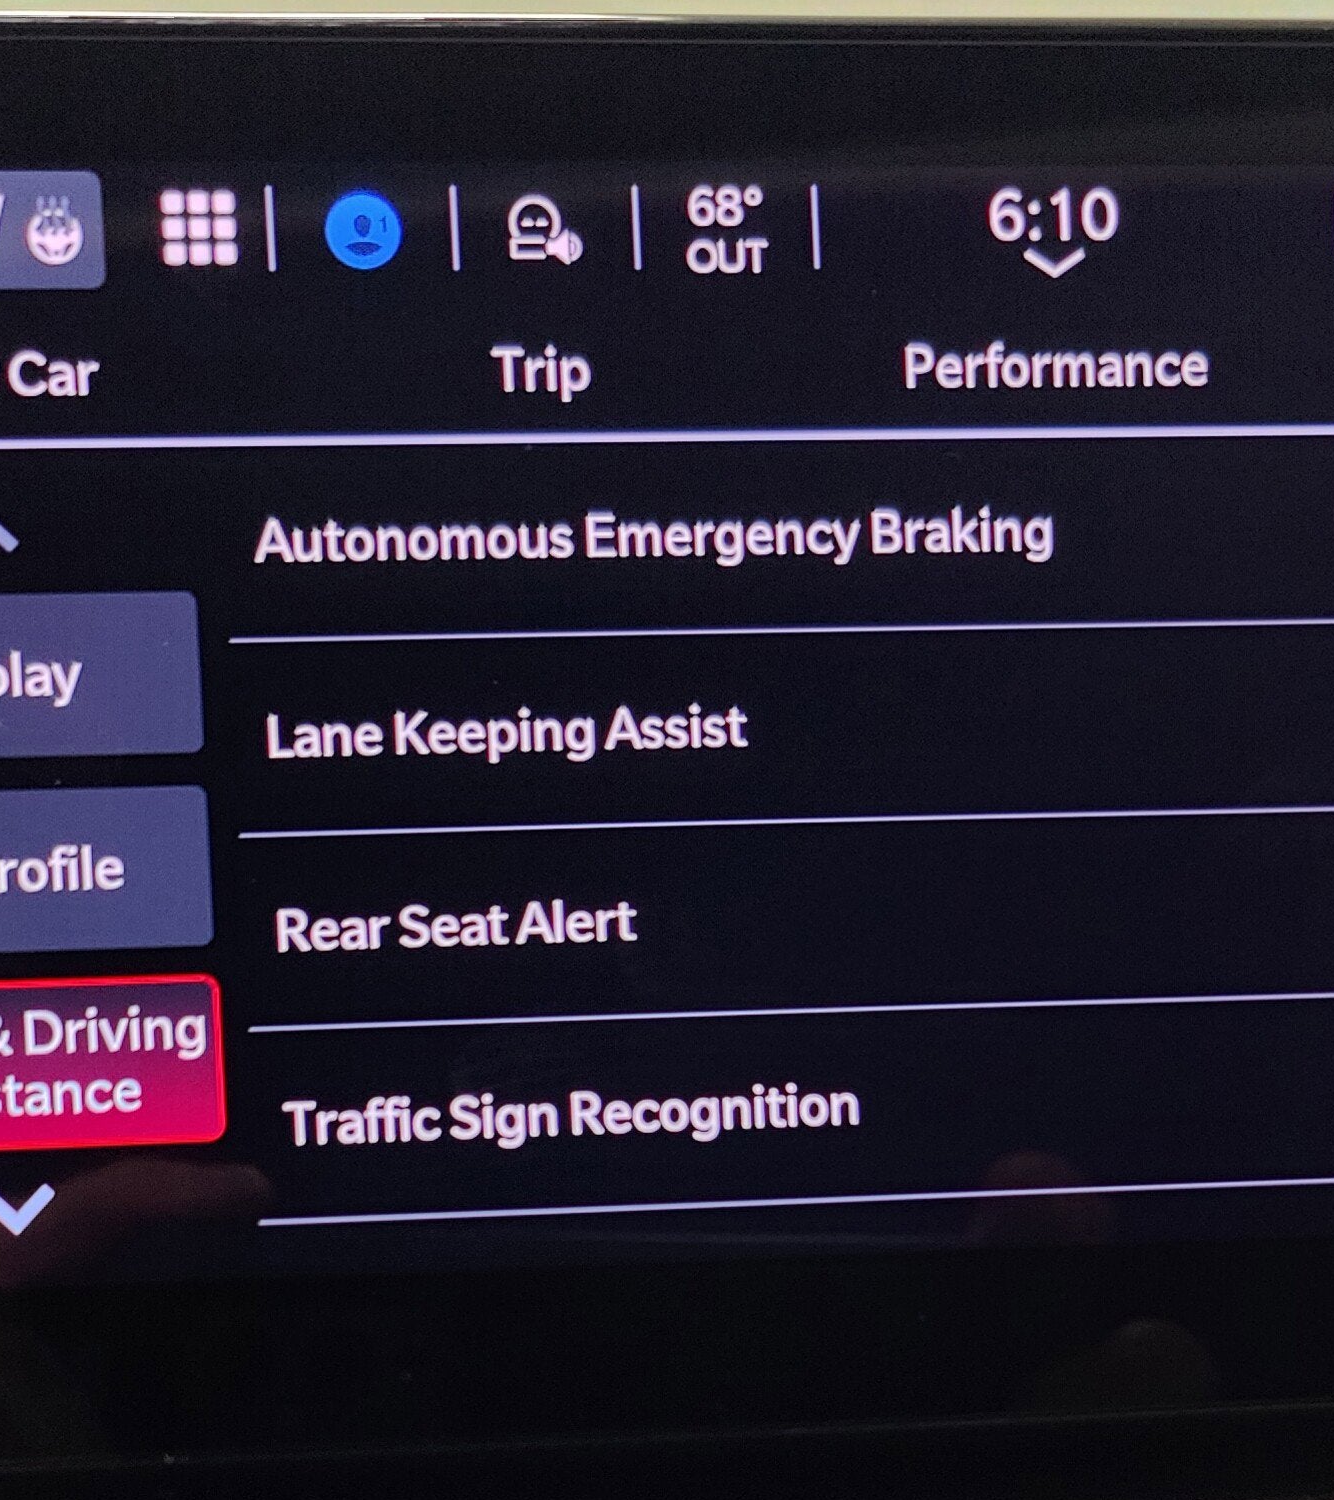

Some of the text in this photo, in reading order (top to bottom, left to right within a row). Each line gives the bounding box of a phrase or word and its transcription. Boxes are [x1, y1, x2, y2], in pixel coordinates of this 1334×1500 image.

[686, 184, 764, 228] 68°
[988, 187, 1119, 243] 6:10
[686, 238, 768, 274] OUT
[7, 350, 100, 397] Car
[491, 345, 592, 402] Trip
[903, 340, 1209, 390] Performance
[254, 505, 1055, 566] Autonomous Emergency Braking
[267, 703, 749, 764] Lane Keeping Assist
[276, 899, 637, 953] Rear Seat Alert
[23, 1002, 208, 1062] Driving
[281, 1082, 861, 1149] Traffic Sign Recognition
